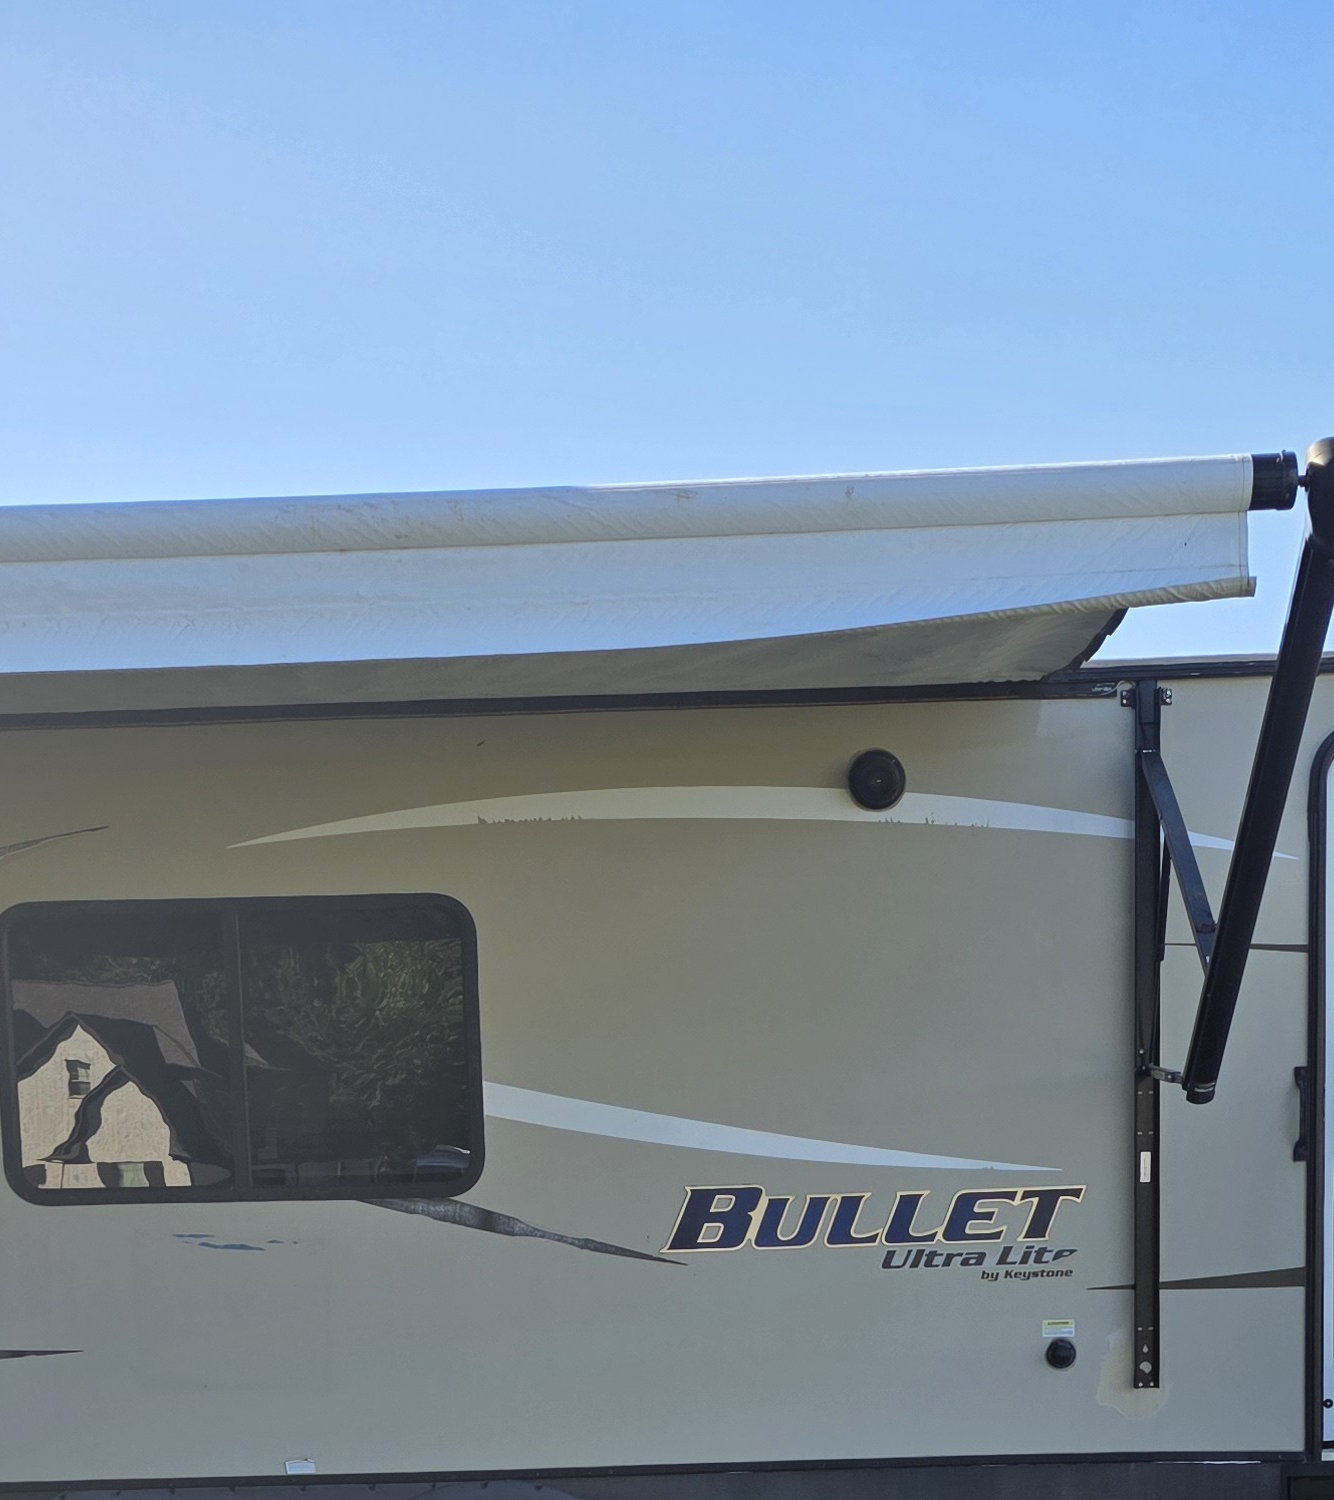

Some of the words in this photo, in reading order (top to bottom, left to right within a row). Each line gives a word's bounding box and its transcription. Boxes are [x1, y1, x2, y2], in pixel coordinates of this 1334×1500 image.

[660, 1184, 1087, 1253] BULLET
[881, 1249, 987, 1269] Ultra
[996, 1245, 1078, 1266] Lite
[980, 1270, 999, 1282] by
[1004, 1269, 1073, 1281] Keystone
